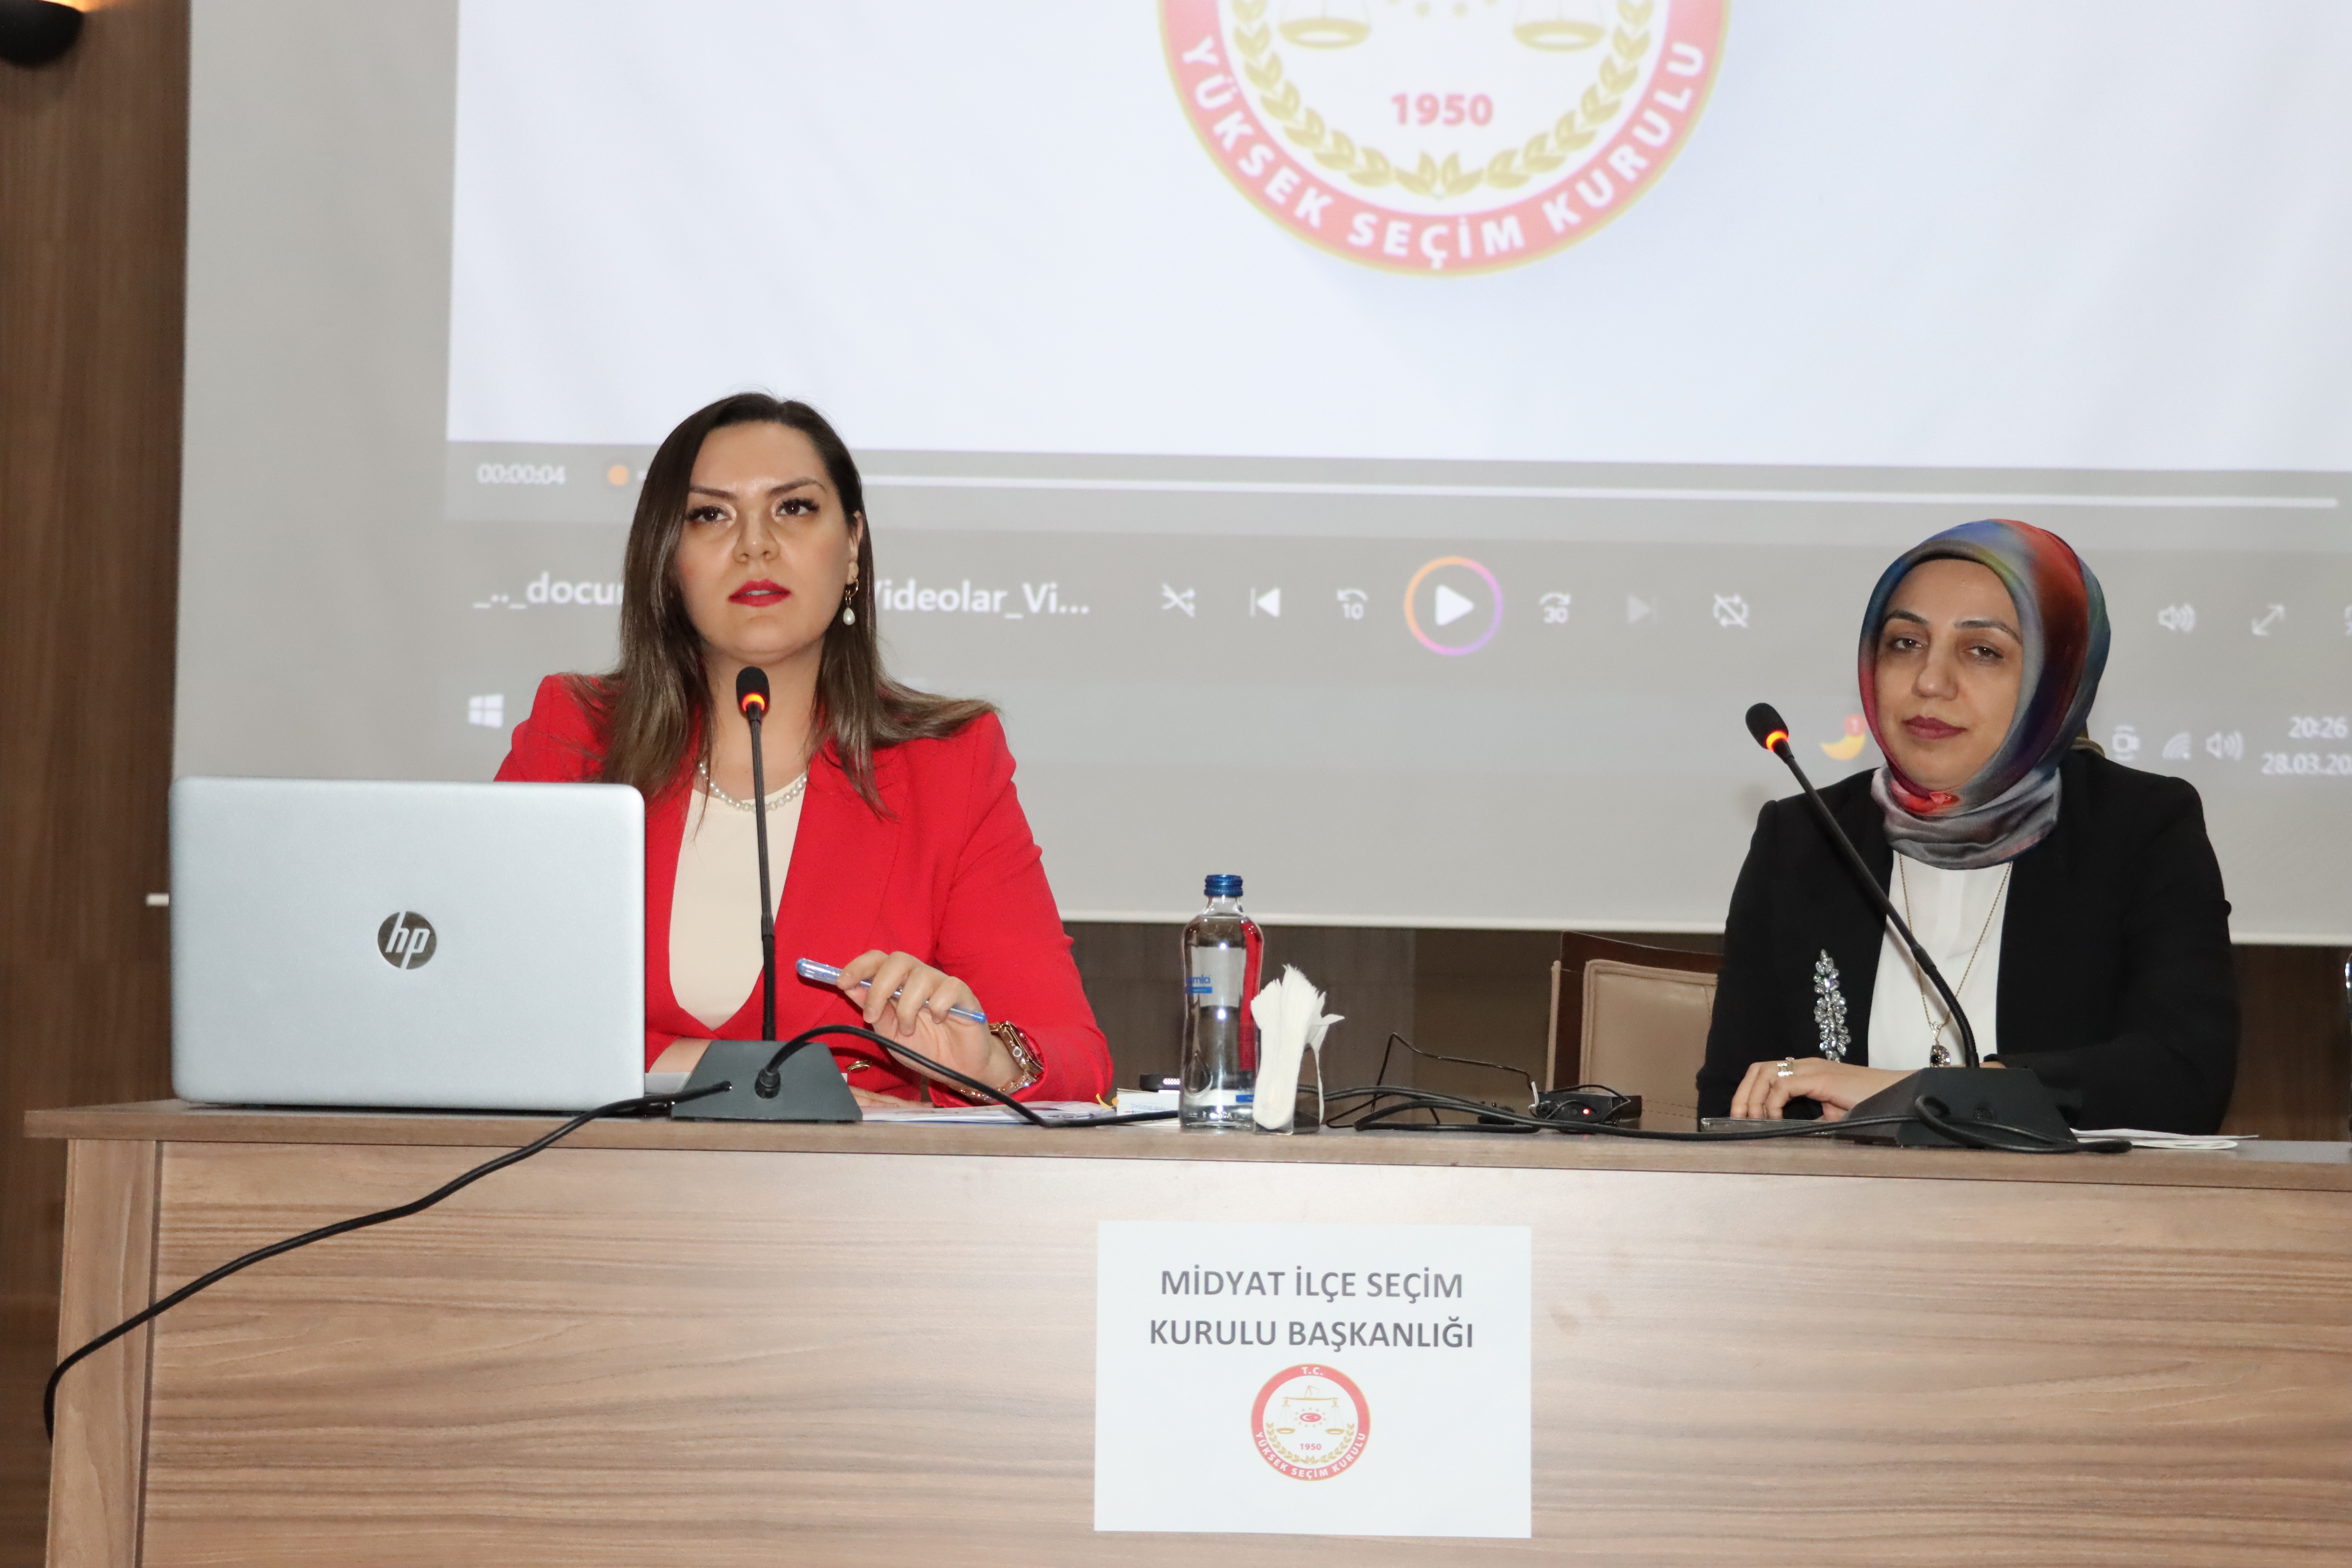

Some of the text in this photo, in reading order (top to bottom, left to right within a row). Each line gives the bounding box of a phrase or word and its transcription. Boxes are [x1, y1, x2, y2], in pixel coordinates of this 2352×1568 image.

[1390, 93, 1494, 126] 1950
[1182, 36, 1705, 269] YÜKSEK SEÇİM KURULU
[477, 464, 566, 484] 00:00:04
[1342, 603, 1364, 620] 10
[1543, 606, 1568, 624] 30
[2289, 716, 2349, 738] 20:26
[384, 911, 431, 970] hp
[1160, 1264, 1463, 1304] MİDYAT İLÇE SEÇİM
[1150, 1316, 1473, 1352] KURULU BAŞKANLIĞI
[1301, 1367, 1323, 1375] T.C.
[1255, 1431, 1366, 1480] YÜKSEK SEÇİM KURULU
